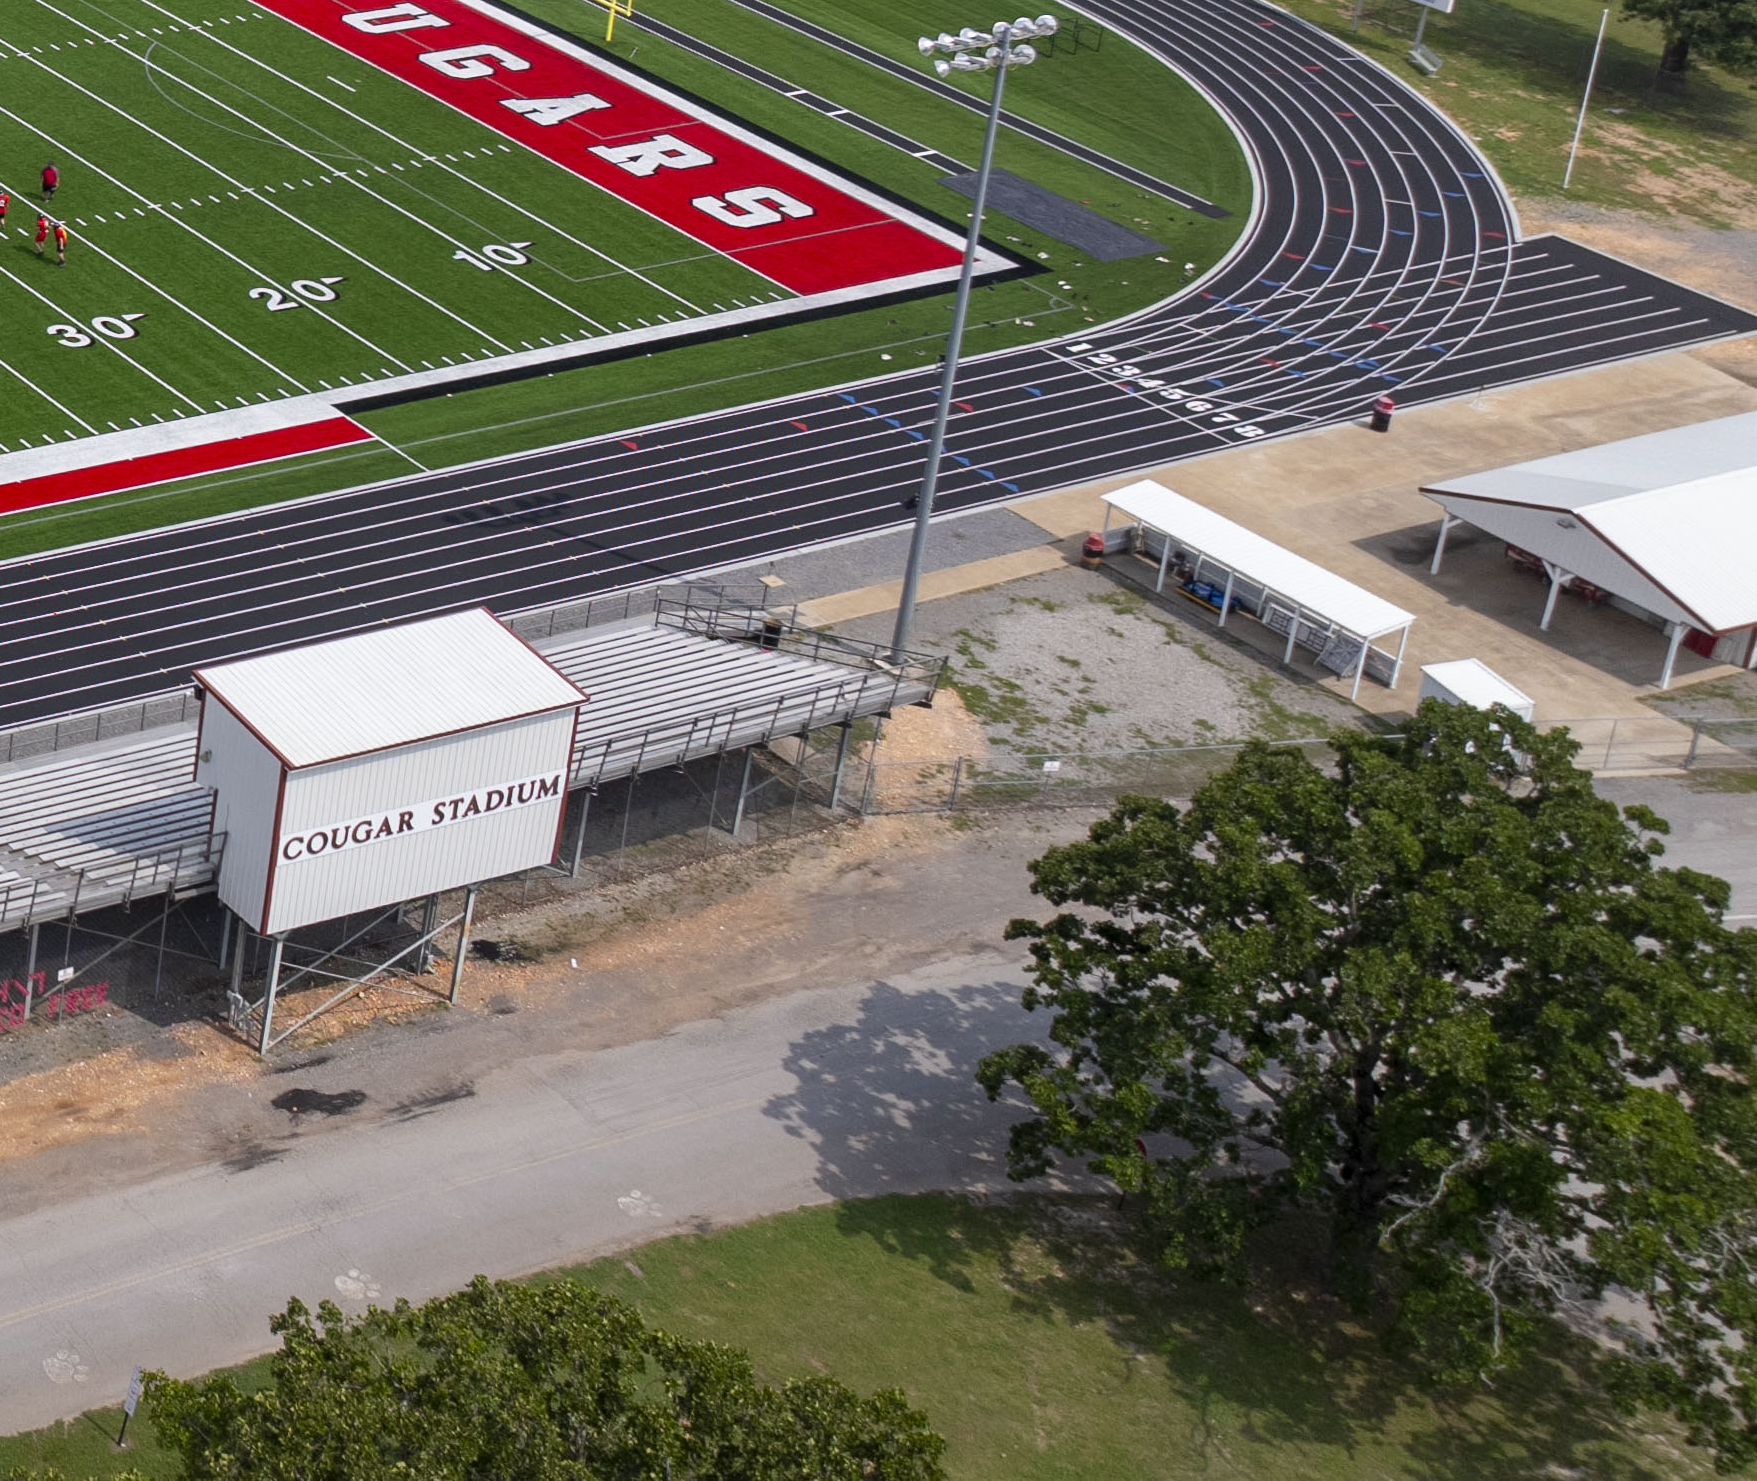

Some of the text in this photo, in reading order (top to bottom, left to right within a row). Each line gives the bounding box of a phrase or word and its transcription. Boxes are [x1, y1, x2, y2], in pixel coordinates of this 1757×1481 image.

[453, 244, 534, 273] 10
[249, 278, 342, 314] 20
[46, 315, 138, 349] 30
[1065, 342, 1266, 438] 1 2 3 4 5 6 7 8
[282, 773, 562, 861] COUGAR STADIUM
[47, 981, 110, 1018] FREE
